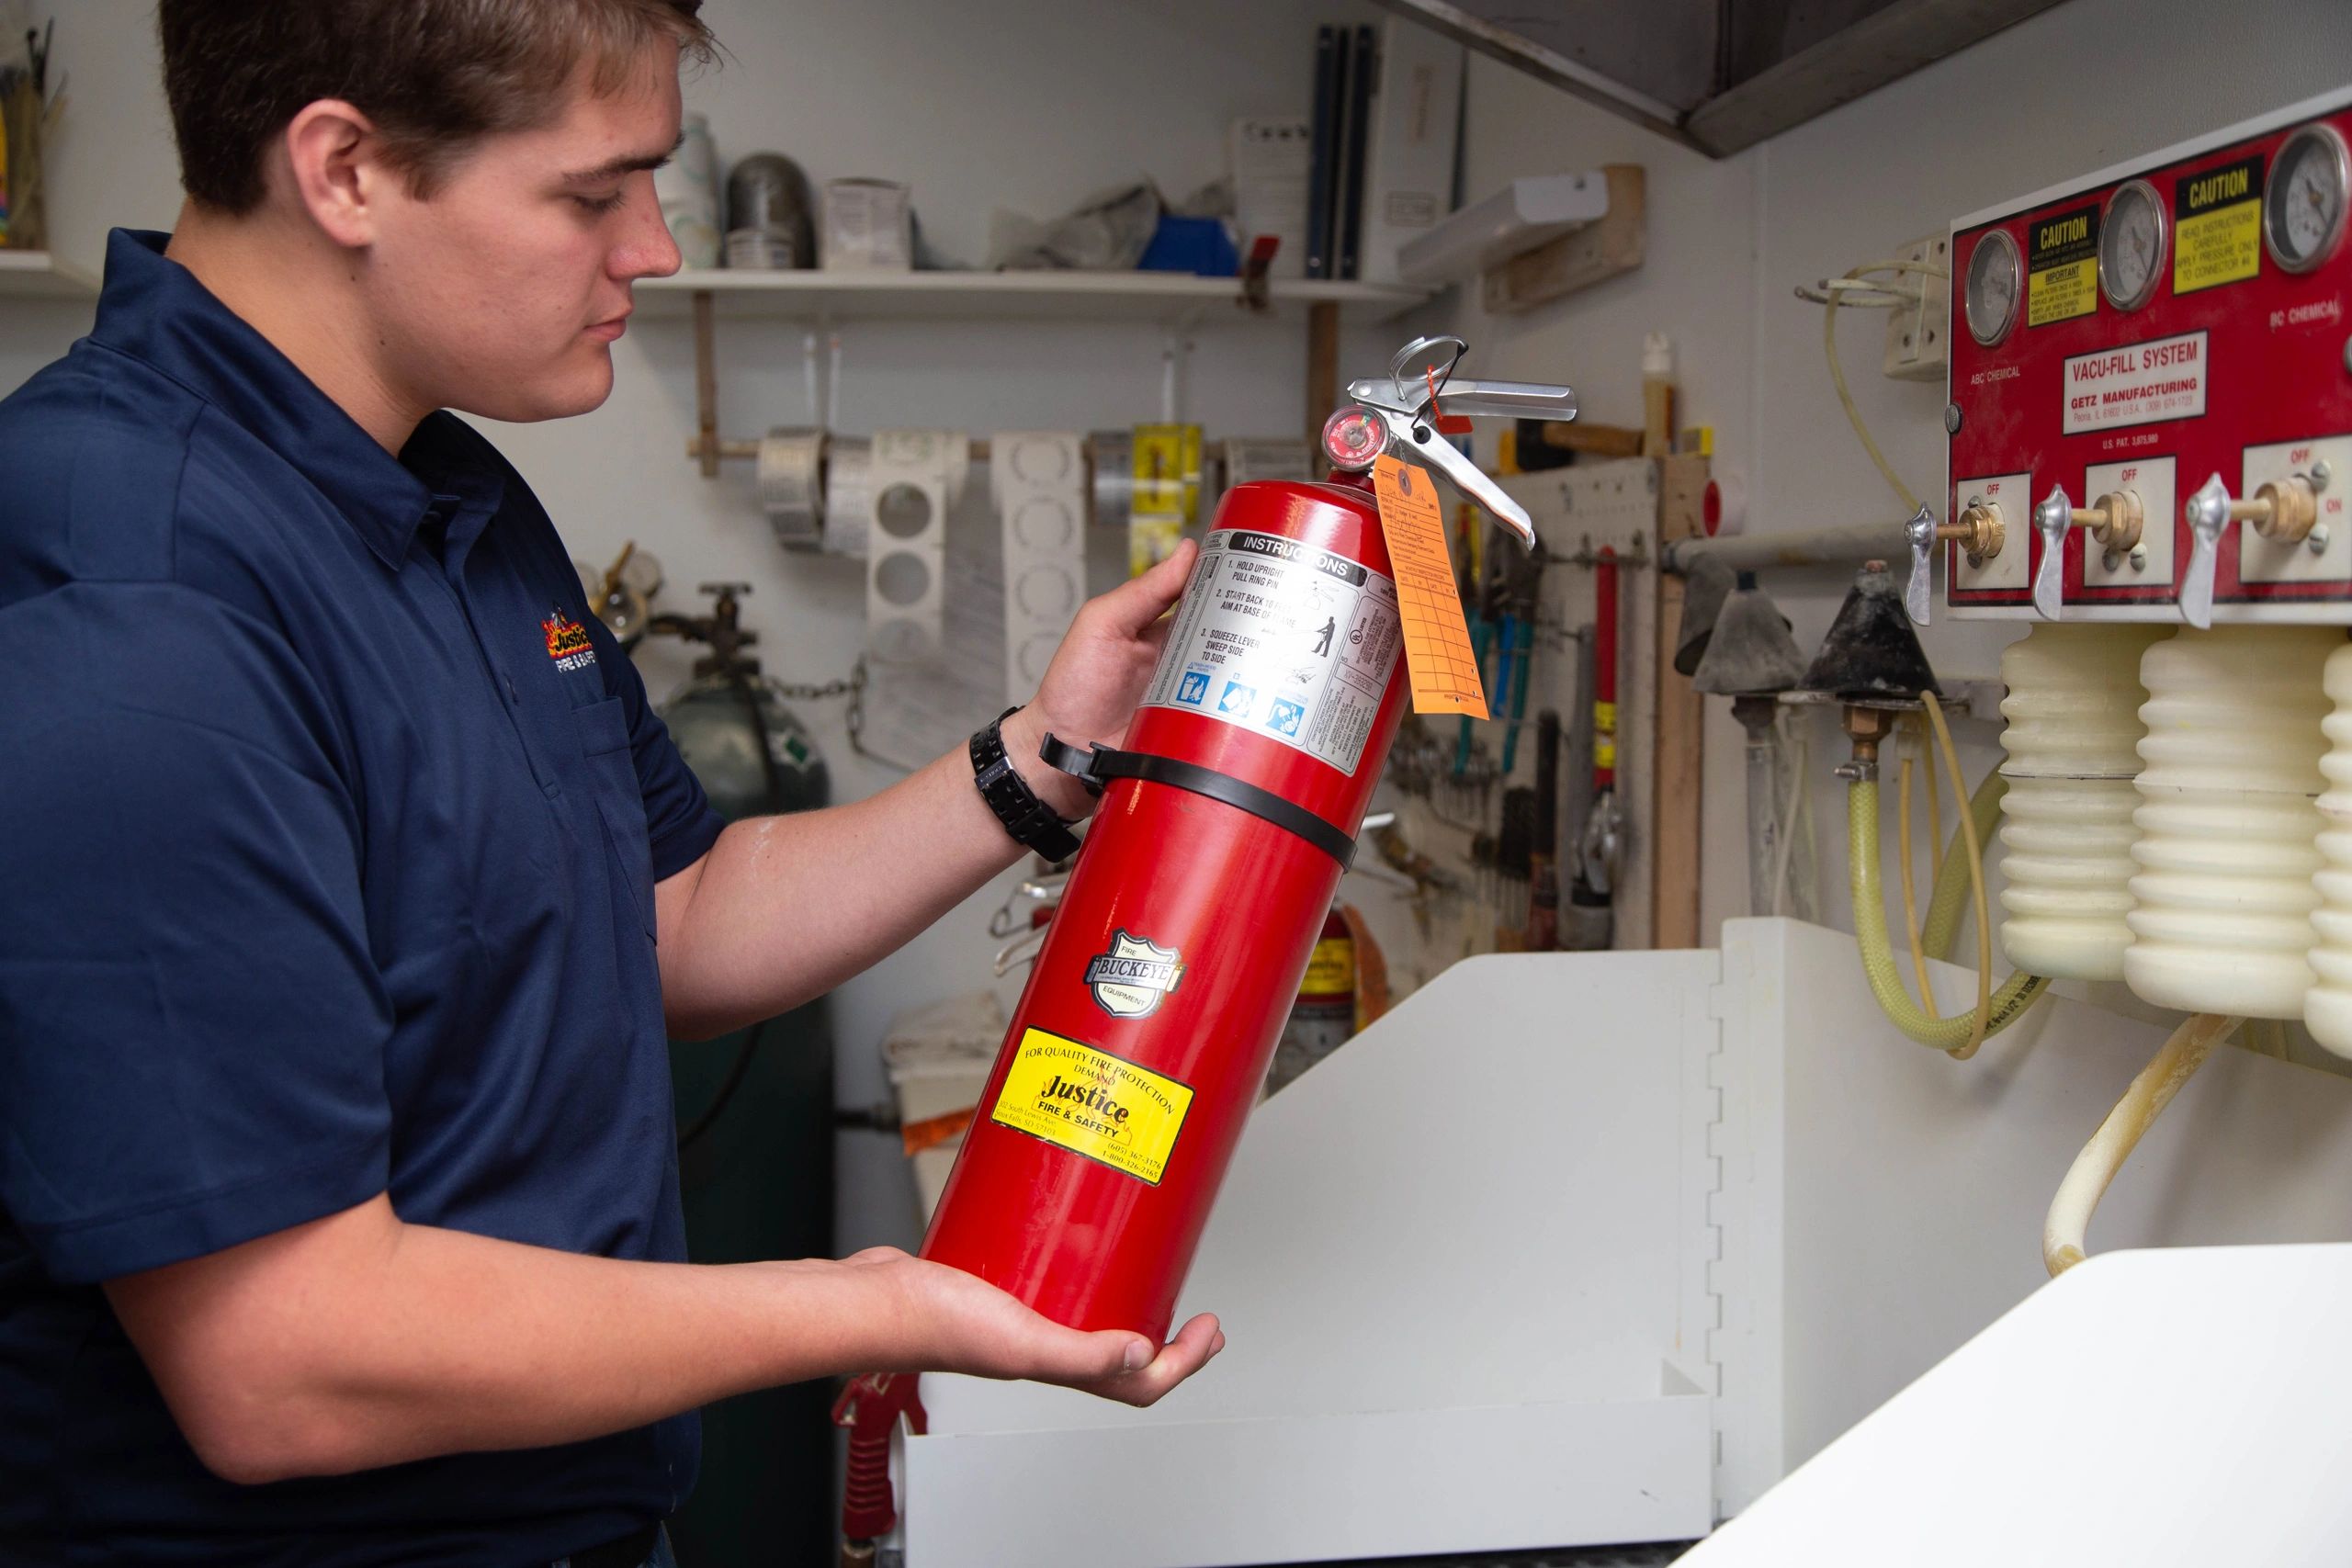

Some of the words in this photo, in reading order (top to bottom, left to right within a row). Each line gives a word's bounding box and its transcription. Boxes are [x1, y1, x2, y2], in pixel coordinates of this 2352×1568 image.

[2189, 167, 2248, 209] CAUTION
[2040, 215, 2087, 251] CAUTION
[2045, 265, 2080, 283] IMPORTANT
[2269, 310, 2285, 327] BC
[2073, 354, 2136, 382] VACU-FILL
[2143, 341, 2198, 370] SYSTEM
[1971, 373, 1984, 385] ABC
[1986, 366, 2020, 382] CHEMICAL
[2071, 395, 2098, 410] GETZ
[2102, 378, 2198, 405] MANUFACTURING
[2102, 439, 2113, 450] U.S.
[2116, 436, 2130, 447] PAT.
[2290, 448, 2310, 464] OFF
[2121, 468, 2137, 482] OFF
[1986, 483, 1999, 495] OFF
[2326, 499, 2342, 513] ON
[1243, 536, 1349, 576] INSTRUCONS
[1228, 559, 1233, 569] 1.
[1237, 560, 1254, 570] HOLD
[1254, 563, 1285, 578] UPRIGHT
[1232, 571, 1248, 582] PULL
[1249, 574, 1266, 586] RING
[1266, 579, 1279, 590] PIN
[1216, 588, 1222, 597] 2.
[1225, 590, 1246, 601] START
[1246, 592, 1264, 605] BACK
[1221, 601, 1235, 611] AIM
[1234, 603, 1243, 612] AT
[1243, 604, 1261, 617] BASE
[554, 626, 588, 651] Justic
[1201, 627, 1205, 637] 3.
[1210, 629, 1238, 643] SQUEEZE
[1238, 636, 1261, 649] LEVER
[1202, 651, 1211, 660] TO
[1210, 653, 1227, 664] SIDE
[1205, 640, 1227, 652] SWEEP
[1228, 645, 1245, 657] SIDE
[1121, 945, 1137, 956] FIRE
[1099, 959, 1171, 980] BUCKEYE
[1102, 985, 1146, 1007] EQUIPMENT
[1025, 1047, 1043, 1058] FOR
[1045, 1046, 1089, 1063] QUALITY
[1090, 1056, 1113, 1072] FIRE
[1114, 1066, 1175, 1115] PROTECTION
[1073, 1064, 1116, 1086] DEMAND
[1041, 1075, 1130, 1122] Justice
[1009, 1103, 1023, 1112] South
[1024, 1109, 1043, 1120] Lewis
[1038, 1101, 1062, 1116] FIRE
[1063, 1110, 1072, 1120] &
[1074, 1114, 1120, 1138] SAFETY
[1024, 1119, 1035, 1127] SD
[1108, 1143, 1127, 1156] (605)
[1102, 1150, 1159, 1179] 1-800-326-2165
